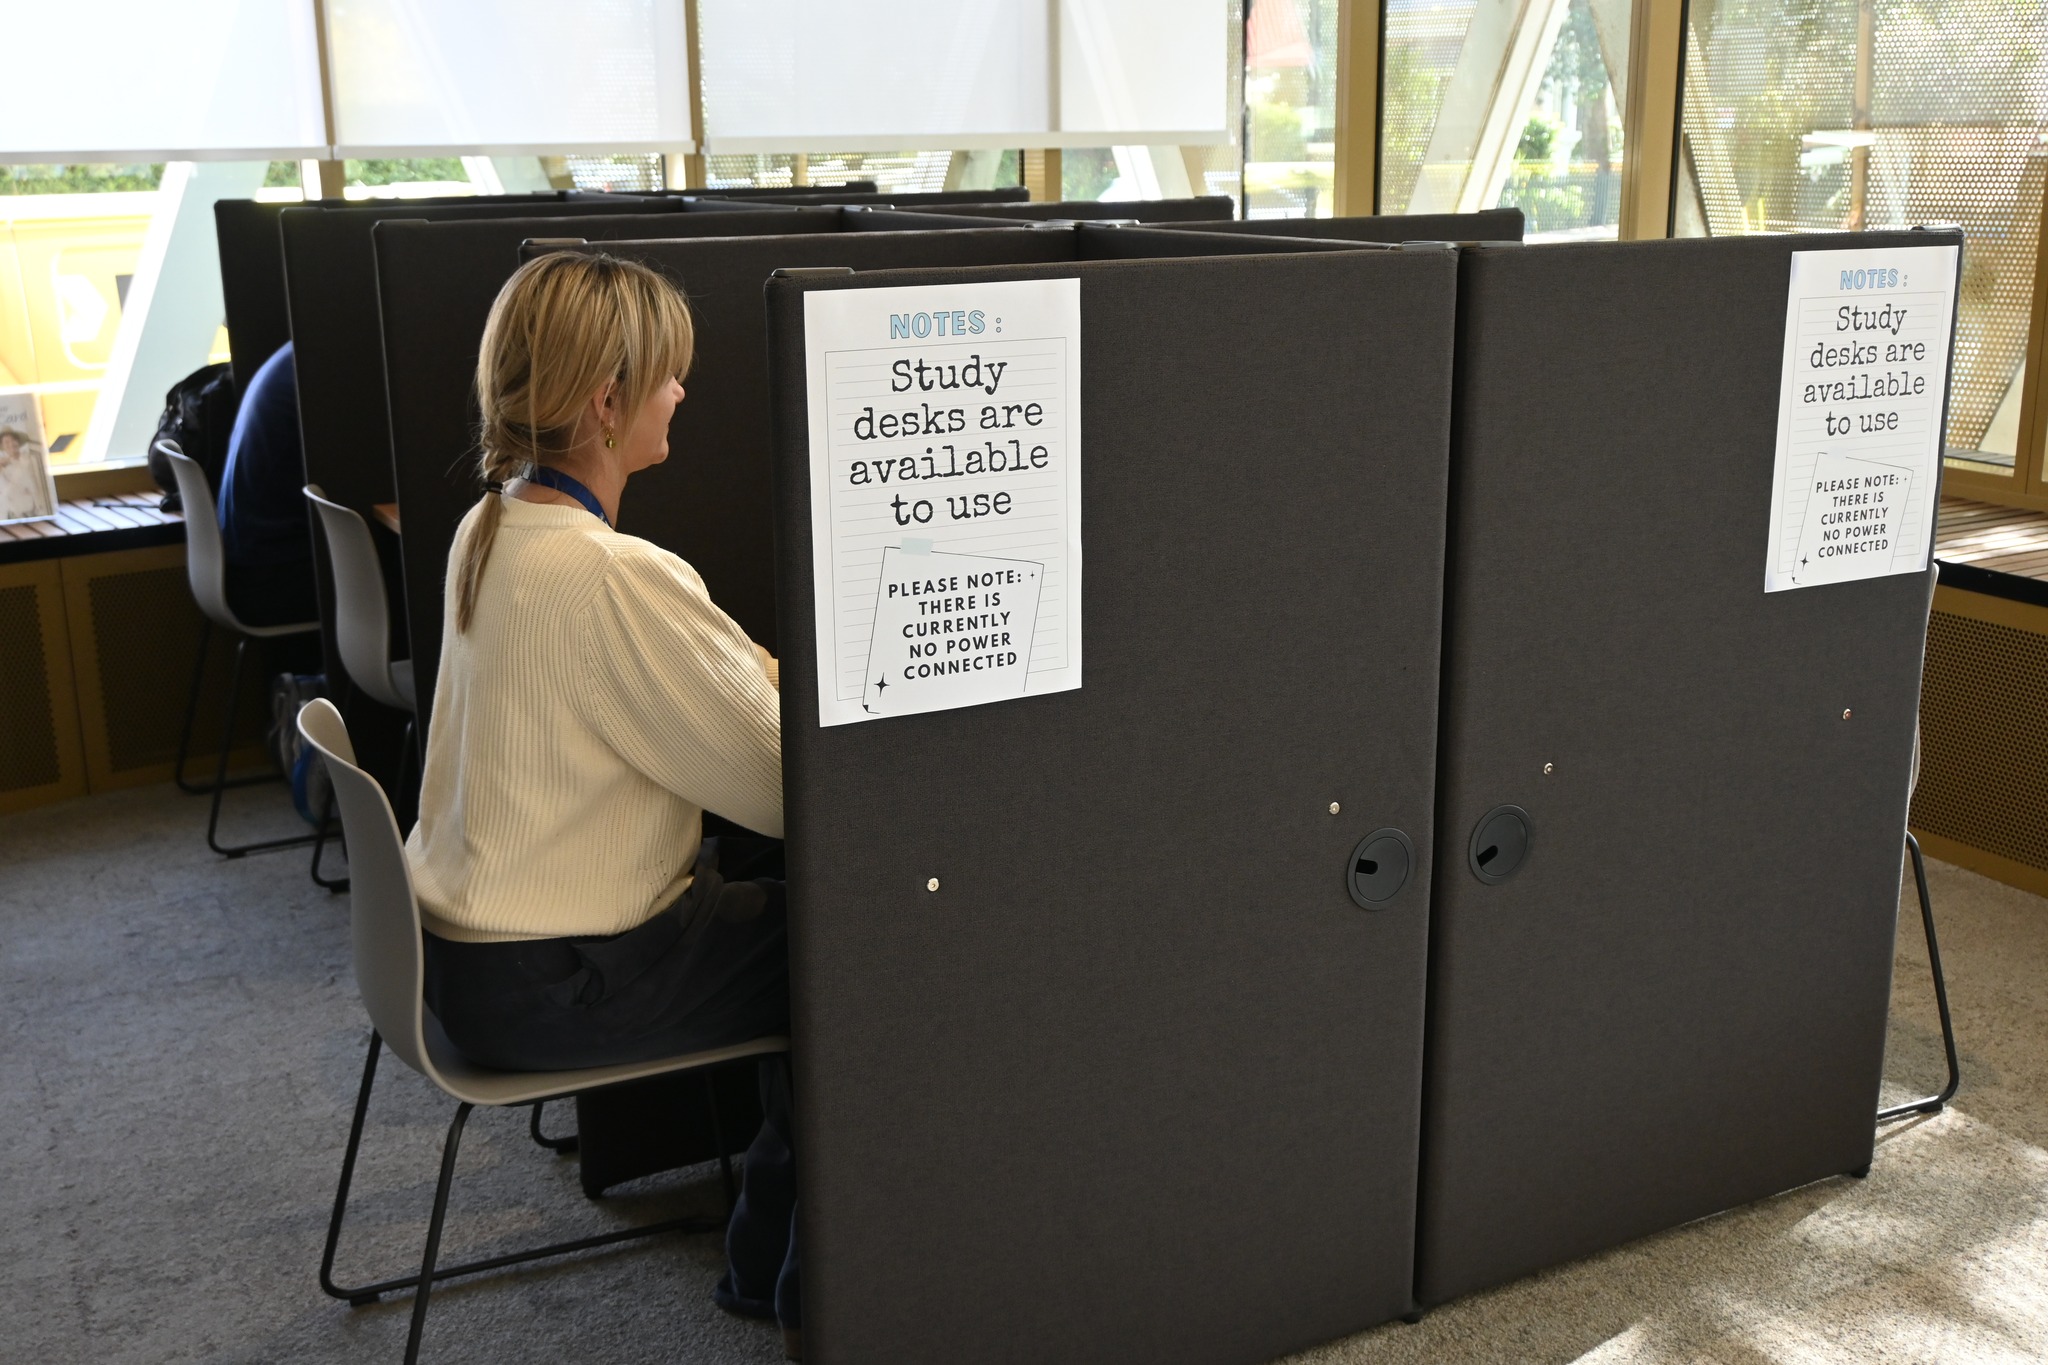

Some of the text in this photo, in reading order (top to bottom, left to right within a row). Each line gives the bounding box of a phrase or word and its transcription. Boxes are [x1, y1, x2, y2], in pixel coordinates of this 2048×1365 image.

[1836, 303, 1908, 336] Study
[1810, 340, 1926, 369] desks are
[891, 354, 1008, 396] Study
[1803, 371, 1926, 404] available
[853, 402, 1044, 441] desks are
[1825, 411, 1899, 437] to use
[849, 439, 1050, 486] available
[1816, 474, 1900, 494] PLEASE NOTE:
[890, 491, 1013, 526] to use
[1832, 491, 1885, 509] THERE IS
[1820, 507, 1889, 527] CURRENTLY
[1823, 523, 1887, 542] NO POWER
[1817, 538, 1889, 559] CONNECTED
[888, 569, 1023, 600] PLEASE NOTE:
[918, 592, 1001, 617] THERE IS
[902, 611, 1012, 639] CURRENTLY
[909, 632, 1012, 660] NO POWER
[903, 651, 1018, 681] CONNECTED
